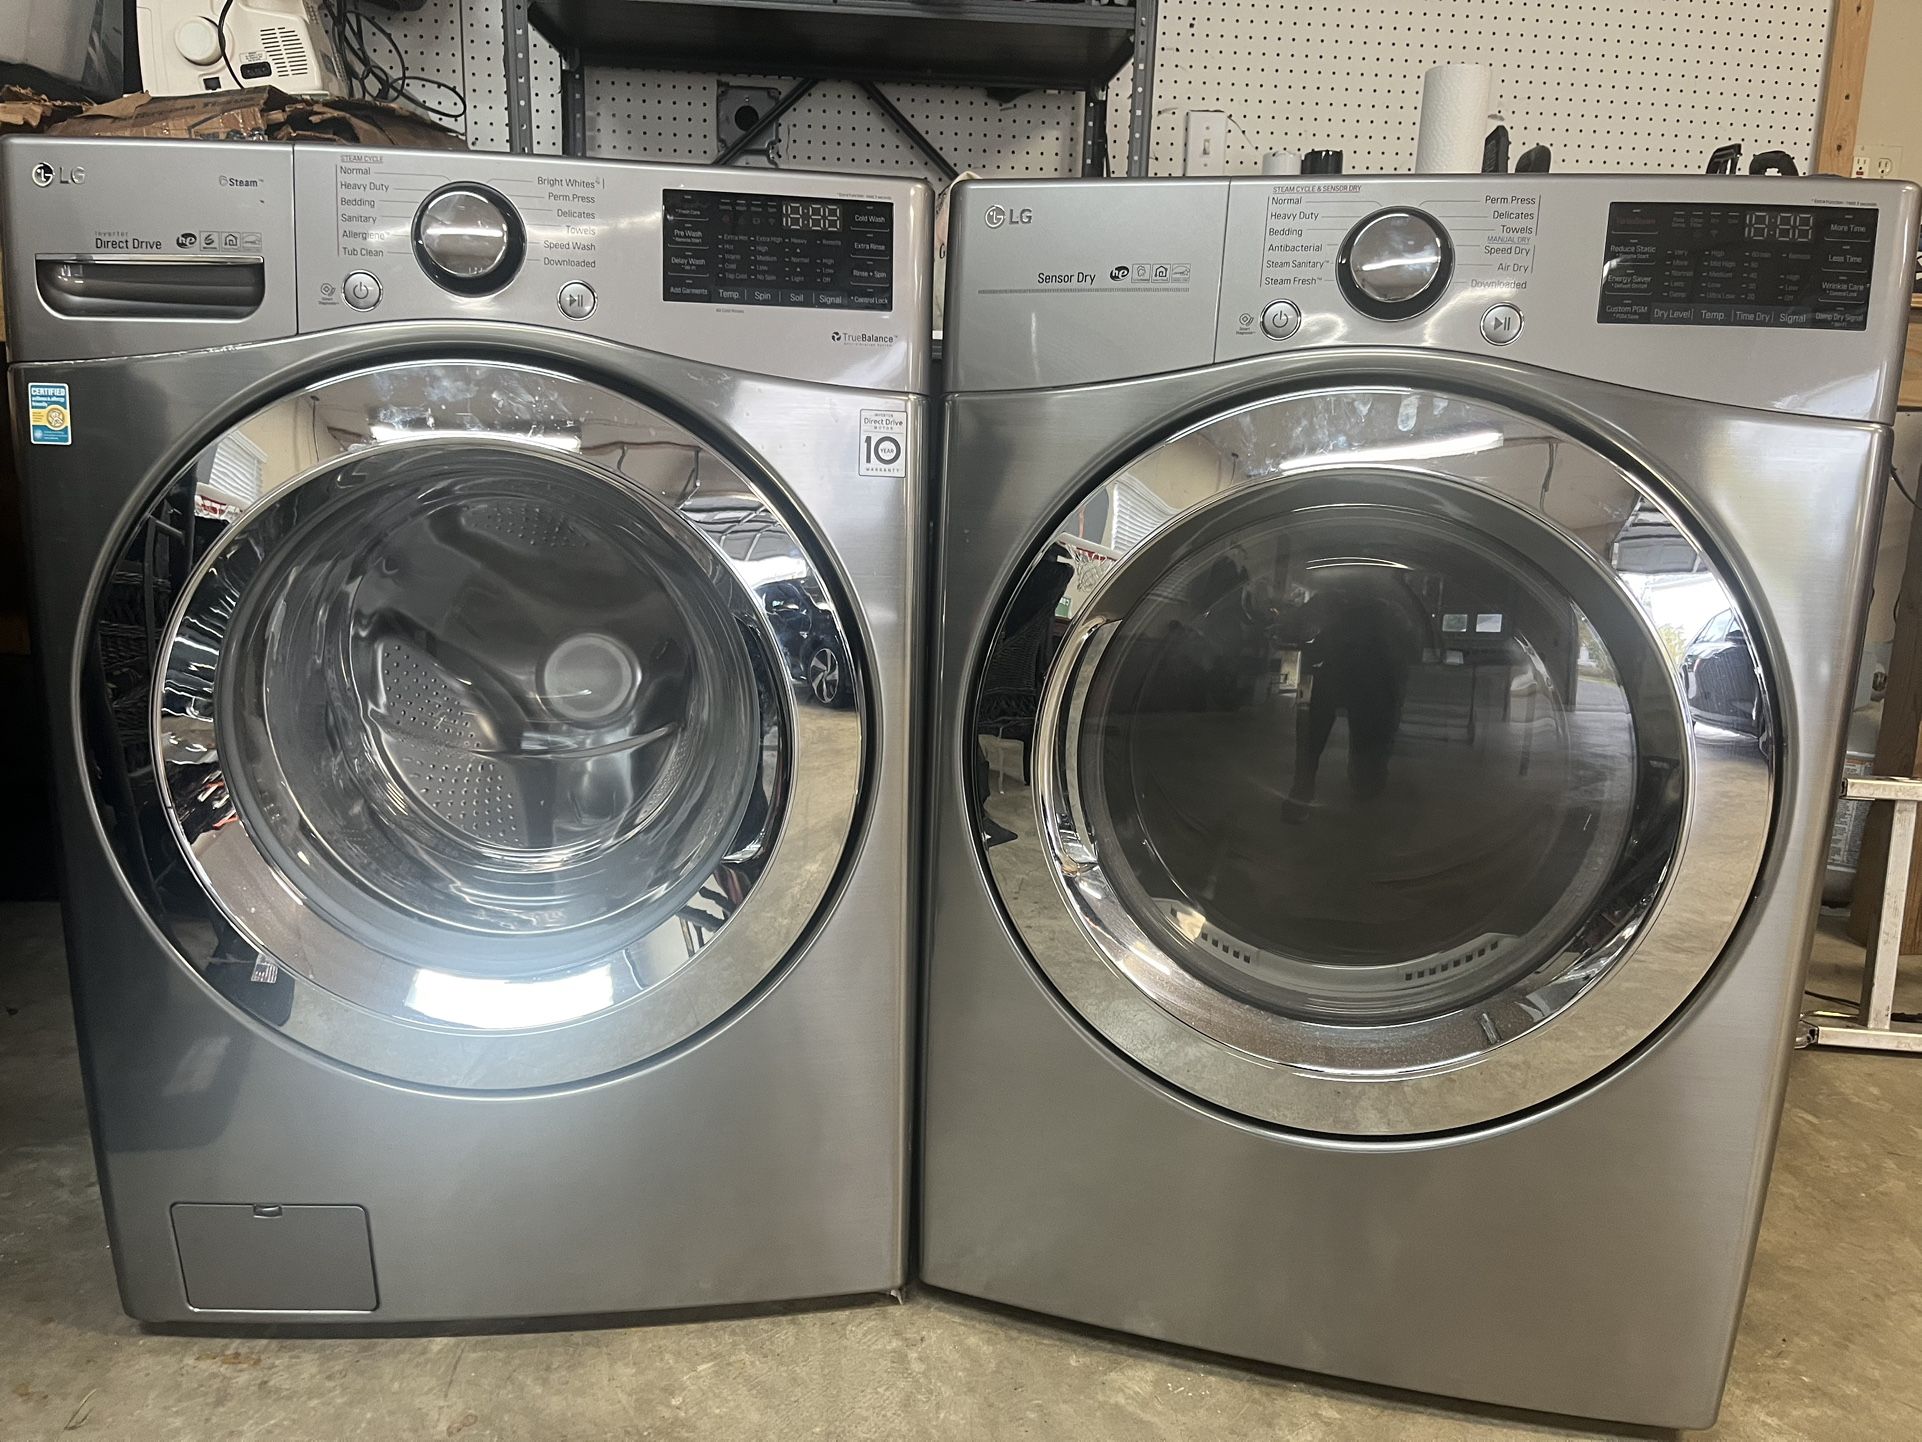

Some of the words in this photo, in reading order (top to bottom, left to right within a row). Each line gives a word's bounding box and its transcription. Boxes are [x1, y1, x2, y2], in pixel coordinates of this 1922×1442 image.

[60, 166, 86, 184] LG
[340, 166, 371, 175] Normal
[229, 178, 258, 187] Steam
[340, 181, 367, 192] Heavy
[369, 182, 389, 192] Duty
[537, 176, 563, 187] Bright
[565, 178, 596, 189] Whites
[340, 197, 376, 208] Bedding
[572, 194, 596, 203] Press
[1271, 197, 1302, 205] Normal
[1511, 195, 1536, 205] Press
[341, 214, 377, 224] Sanitary
[557, 208, 596, 220] Delicates
[854, 214, 868, 222] Cold
[1008, 208, 1032, 225] LG
[1270, 212, 1296, 221] Heavy
[1299, 212, 1319, 220] Duty
[1493, 211, 1534, 220] Delicates
[566, 225, 596, 235] Towels
[685, 230, 702, 238] Wash
[1269, 228, 1303, 237] Bedding
[1500, 225, 1533, 234] Towels
[95, 238, 129, 250] Direct
[132, 238, 162, 250] Drive
[544, 240, 570, 250] Speed
[572, 242, 596, 251] Wash
[1268, 244, 1322, 252] Antibacterial
[342, 247, 358, 256] Tub
[360, 248, 384, 257] Clean
[1484, 246, 1512, 255] Speed
[1514, 246, 1530, 256] Dry
[544, 257, 596, 268] Downloaded
[672, 257, 688, 265] Delay
[1266, 260, 1290, 268] Steam
[1497, 263, 1511, 272] Air
[1513, 264, 1528, 273] Dry
[1038, 272, 1074, 284] Sensor
[1077, 272, 1096, 286] Dry
[1265, 277, 1291, 286] Steam
[1471, 279, 1527, 289] Downloaded
[754, 292, 772, 300] Spin
[790, 294, 804, 302] Soil
[820, 294, 842, 304] Signal
[1654, 309, 1668, 319] Dry
[1670, 310, 1691, 319] Level
[1736, 311, 1755, 320] Time
[1756, 313, 1771, 323] Dry
[1780, 314, 1807, 324] Signal
[1834, 313, 1844, 321] Dry
[842, 332, 894, 343] TrueBalance
[31, 388, 66, 396] CERTIFIED
[886, 418, 904, 426] Drive
[864, 436, 902, 465] 10
